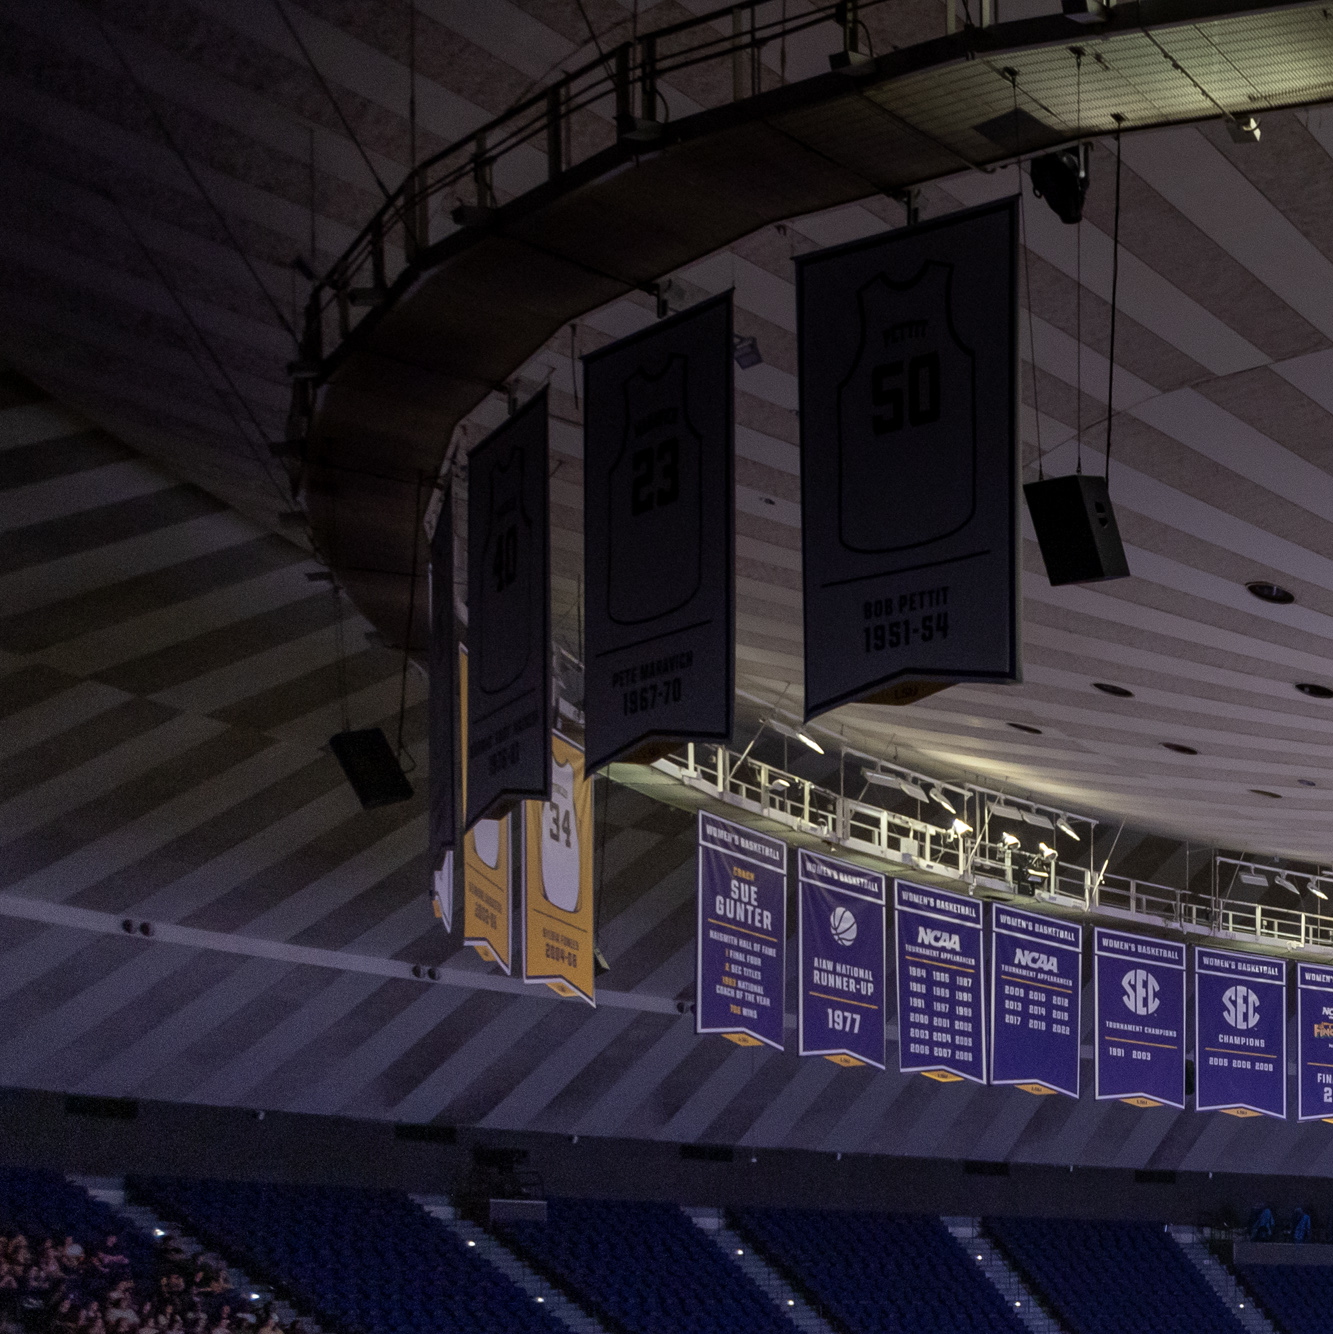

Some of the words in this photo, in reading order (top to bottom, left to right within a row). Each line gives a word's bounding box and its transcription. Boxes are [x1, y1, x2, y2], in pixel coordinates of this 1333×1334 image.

[872, 351, 941, 437] 50
[631, 436, 680, 516] 23
[862, 599, 894, 622] BOB
[898, 586, 950, 615] PETTIT
[863, 611, 950, 653] 1951-54
[611, 665, 637, 688] PETE
[622, 677, 682, 715] 1967-70
[731, 879, 758, 905] SUE
[902, 891, 934, 907] WOMEN'S
[936, 900, 976, 917] BASKETBALL
[715, 896, 772, 931] GUNTER
[918, 926, 961, 951] NCAA
[1000, 914, 1033, 931] WOMEN'S
[1035, 923, 1075, 941] BASKETBALL
[1014, 948, 1058, 973] NCAA
[1102, 938, 1136, 951] WOMEN'S
[1138, 944, 1178, 959] BASKETBALL
[814, 957, 834, 973] AIAW
[836, 963, 873, 981] NATIONAL
[1203, 957, 1235, 969] WOMEN'S
[1238, 962, 1279, 975] BASKETBALL
[813, 971, 874, 996] RUNNER-UP
[1122, 969, 1160, 1015] SEC
[827, 1008, 860, 1034] 1977
[1222, 986, 1260, 1030] SEC
[1106, 1021, 1142, 1033] TOURNAMENT
[1145, 1027, 1176, 1037] CHAMPIONS
[1219, 1034, 1265, 1047] CHAMPIONS
